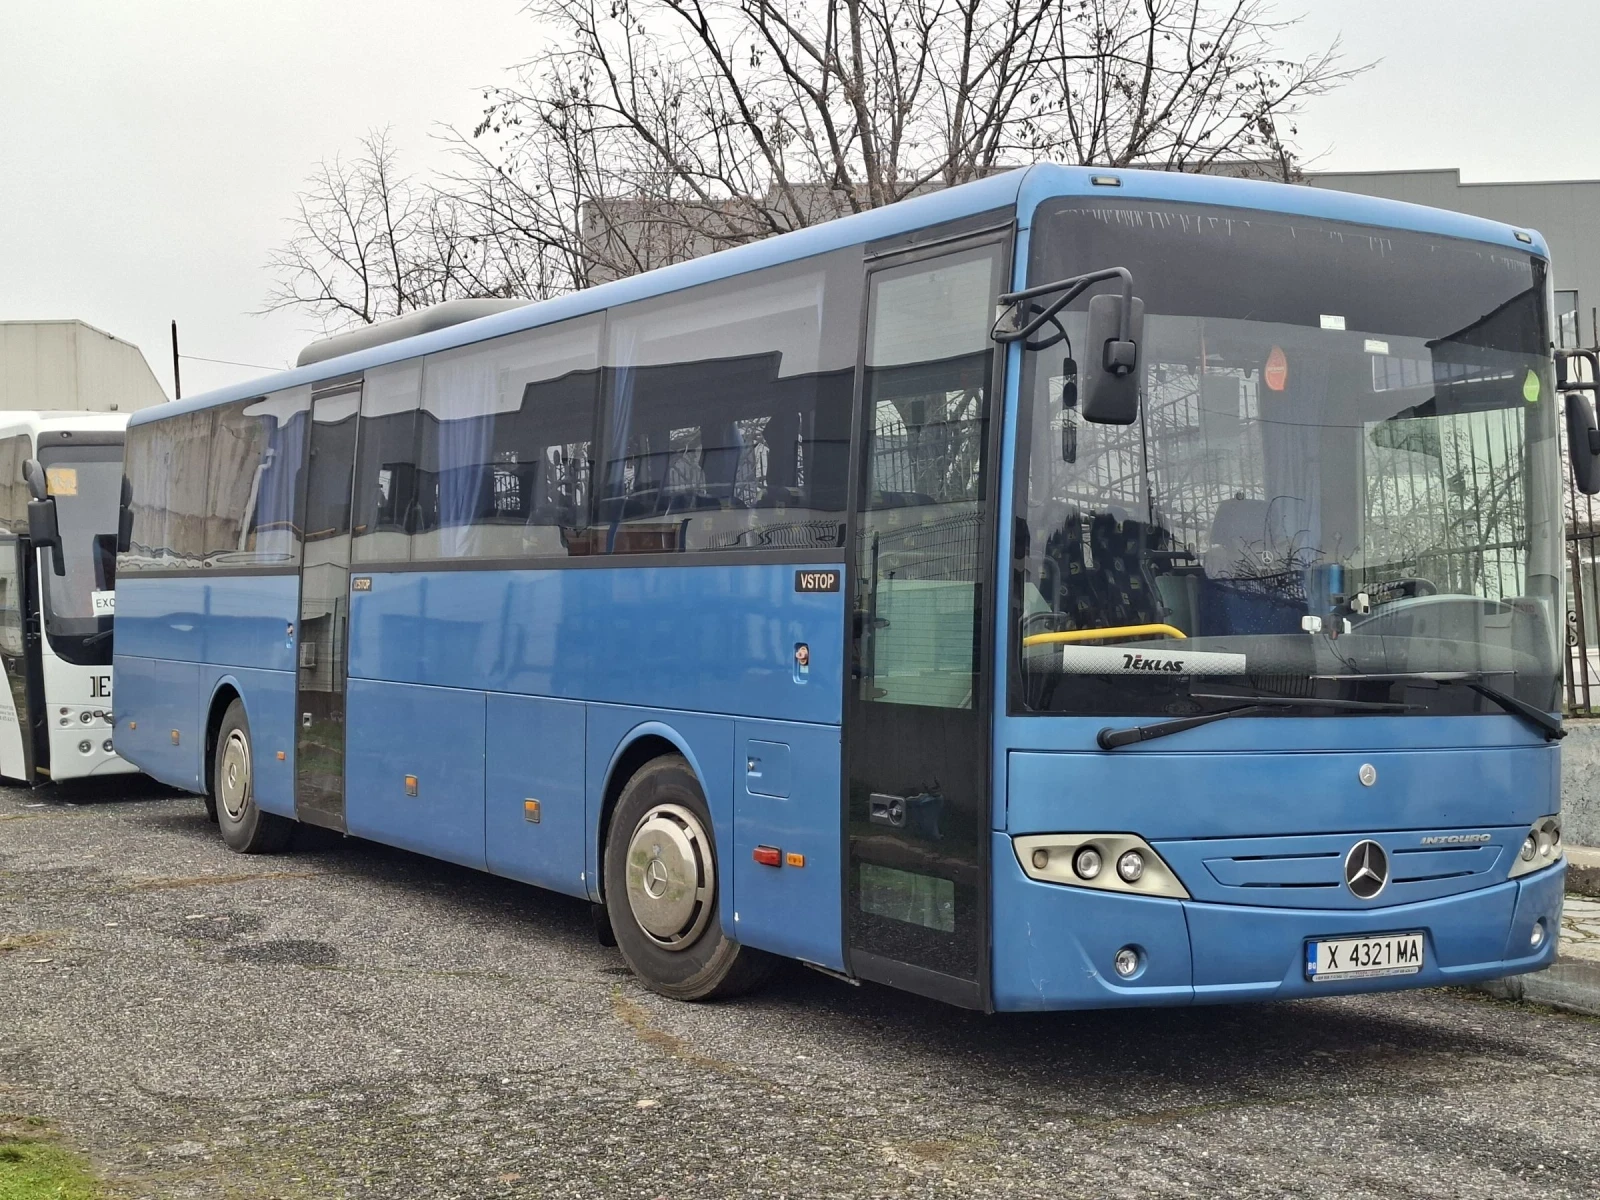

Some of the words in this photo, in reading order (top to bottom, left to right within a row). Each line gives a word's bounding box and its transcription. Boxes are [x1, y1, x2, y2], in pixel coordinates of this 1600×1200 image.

[800, 573, 835, 589] VSTOP
[1123, 654, 1184, 672] TEKLAS
[1420, 833, 1492, 845] INTOURO
[1327, 945, 1339, 969] X
[1349, 941, 1391, 967] 4321
[1397, 939, 1419, 963] MA
